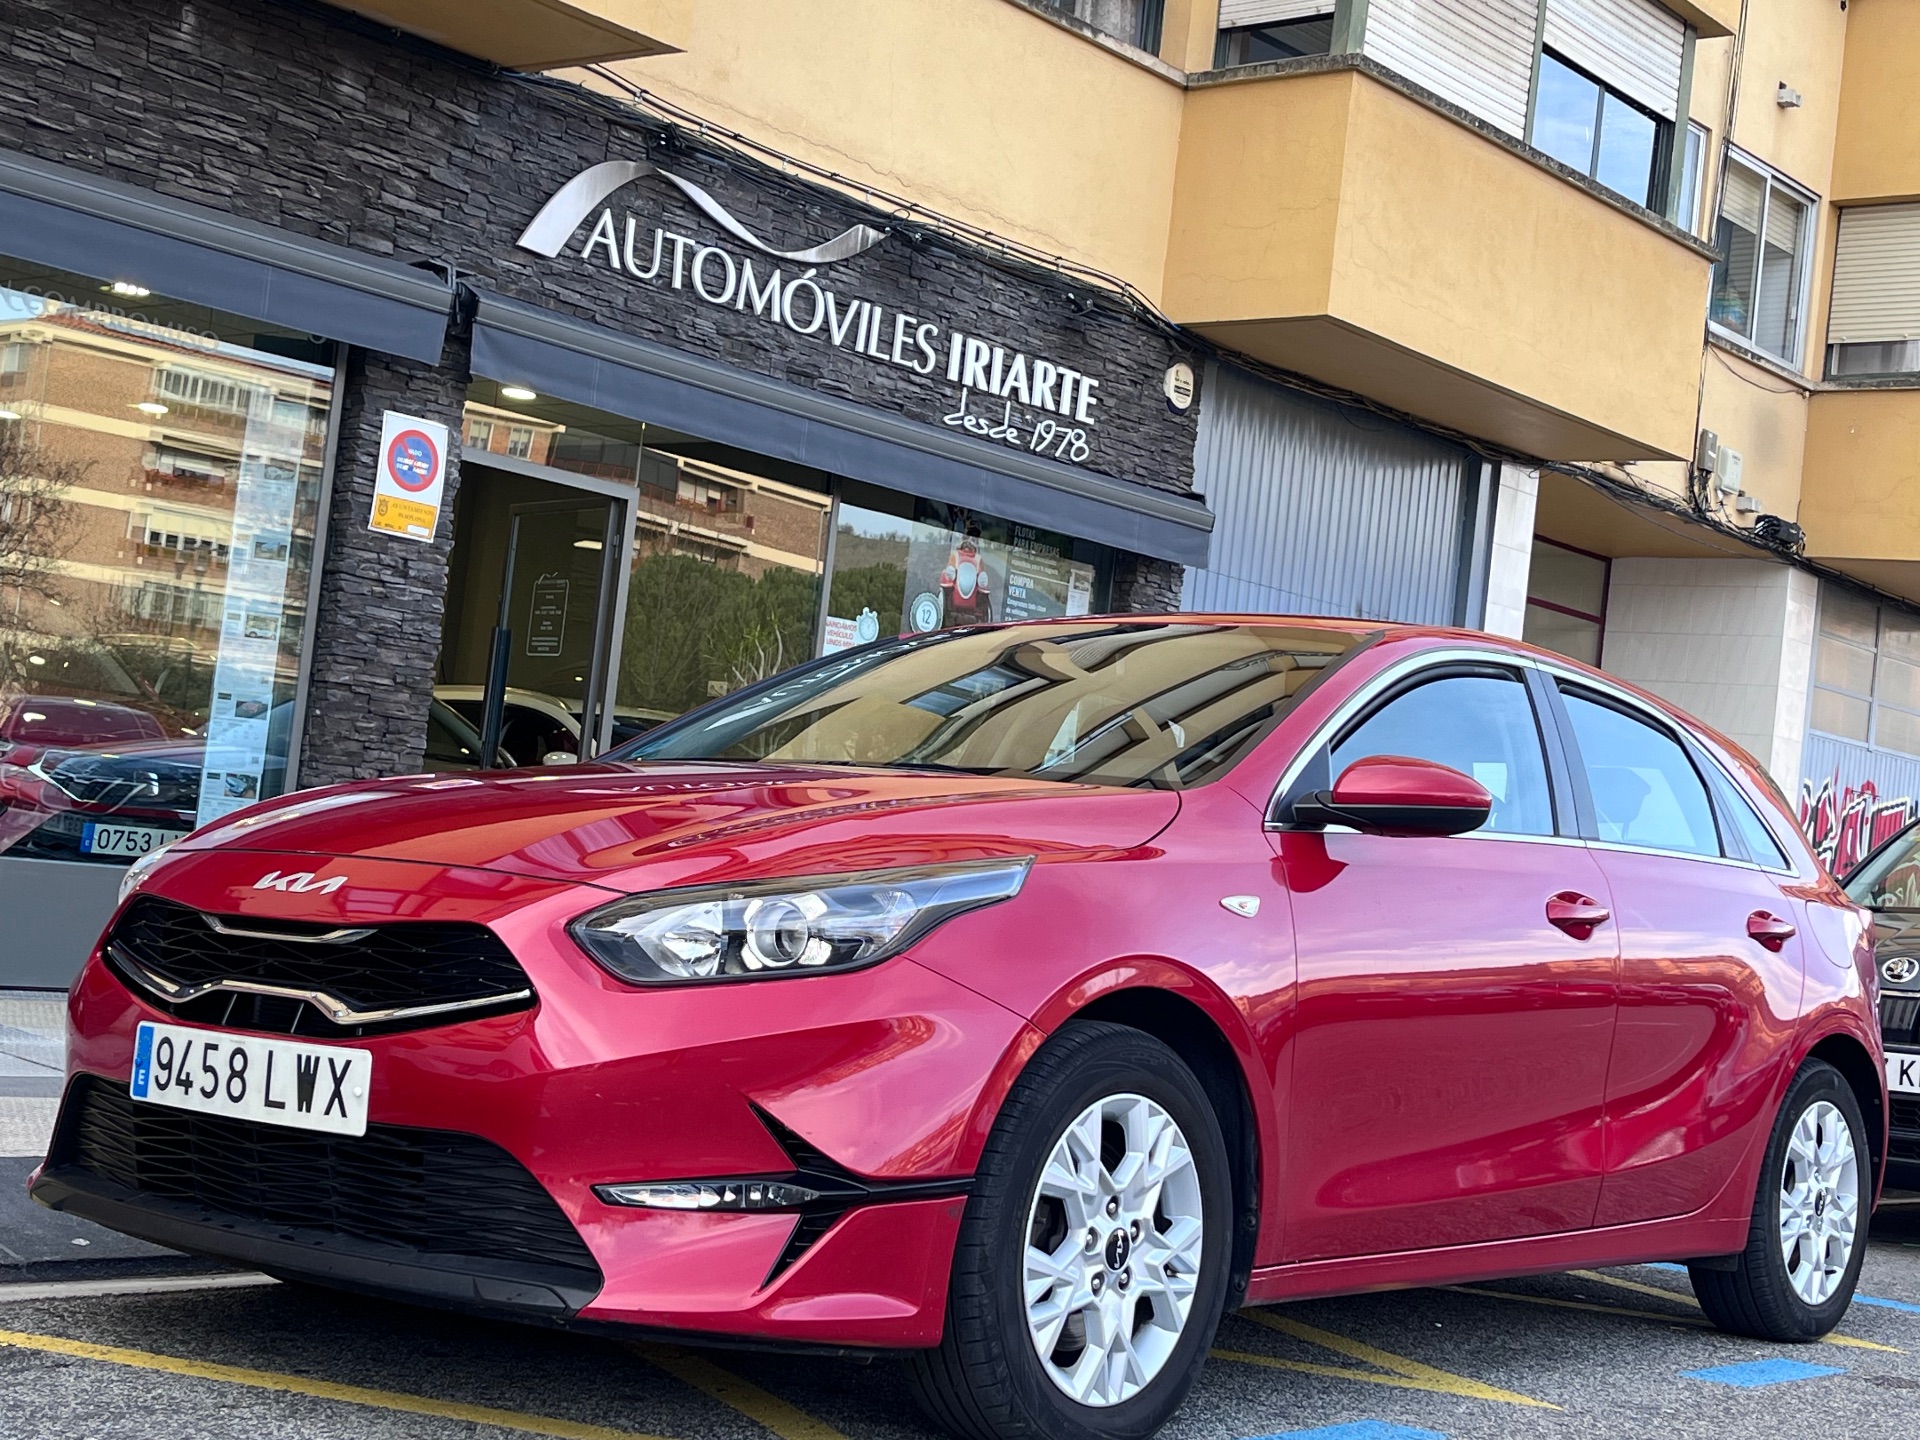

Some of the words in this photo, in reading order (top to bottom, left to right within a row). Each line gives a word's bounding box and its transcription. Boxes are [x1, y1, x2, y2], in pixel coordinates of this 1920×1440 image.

[580, 208, 938, 374] AUTOMÓVILES
[947, 333, 1099, 425] IRIARTE
[943, 387, 1020, 444] desde
[1030, 420, 1089, 462] 1978
[922, 608, 932, 625] 12
[97, 828, 152, 853] 0753
[154, 1036, 248, 1104] 9458
[264, 1049, 352, 1119] LWX
